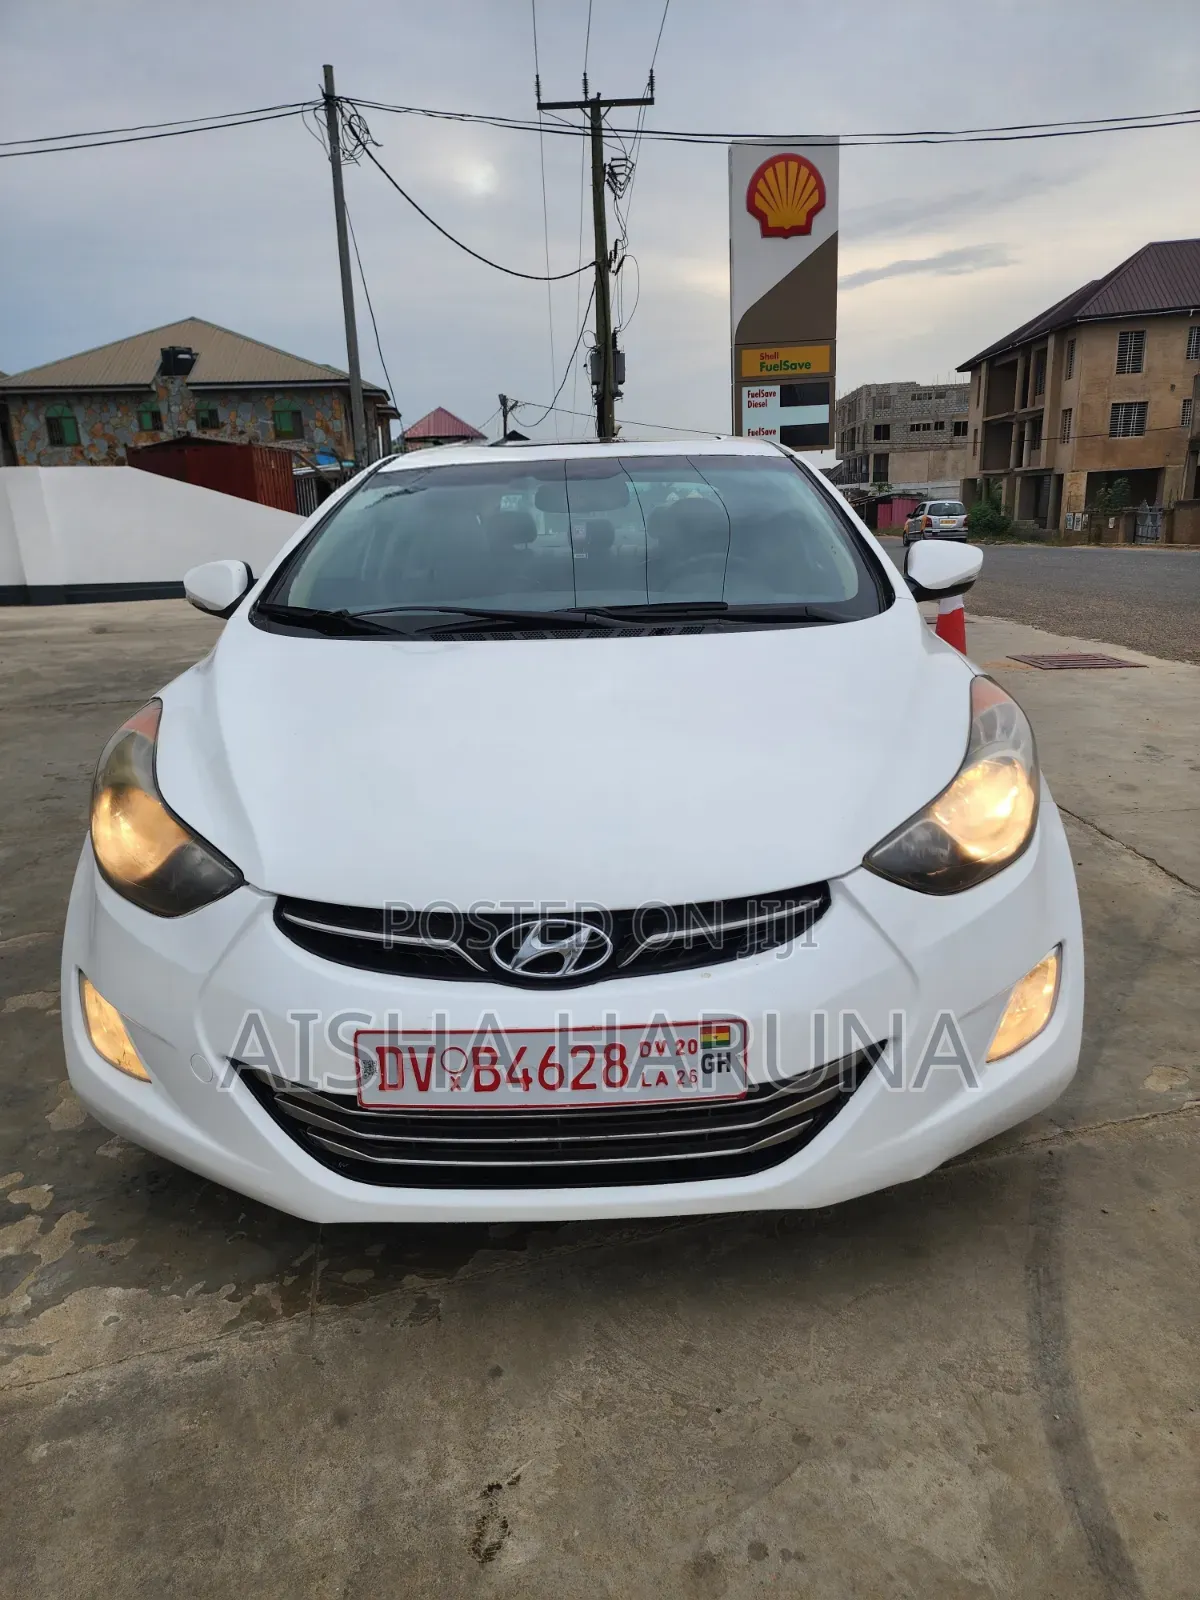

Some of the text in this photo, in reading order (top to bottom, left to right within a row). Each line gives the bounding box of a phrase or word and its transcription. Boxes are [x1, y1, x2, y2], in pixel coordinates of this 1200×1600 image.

[760, 352, 779, 360] Shell
[760, 360, 811, 372] FuelSave
[747, 389, 777, 398] FuelSave
[747, 399, 768, 408] Diesel
[747, 427, 777, 437] FuelSave
[675, 1038, 698, 1056] 20
[375, 1045, 436, 1092] DV
[472, 1042, 629, 1092] B4628
[701, 1052, 731, 1074] GH
[641, 1068, 698, 1087] LA 26
